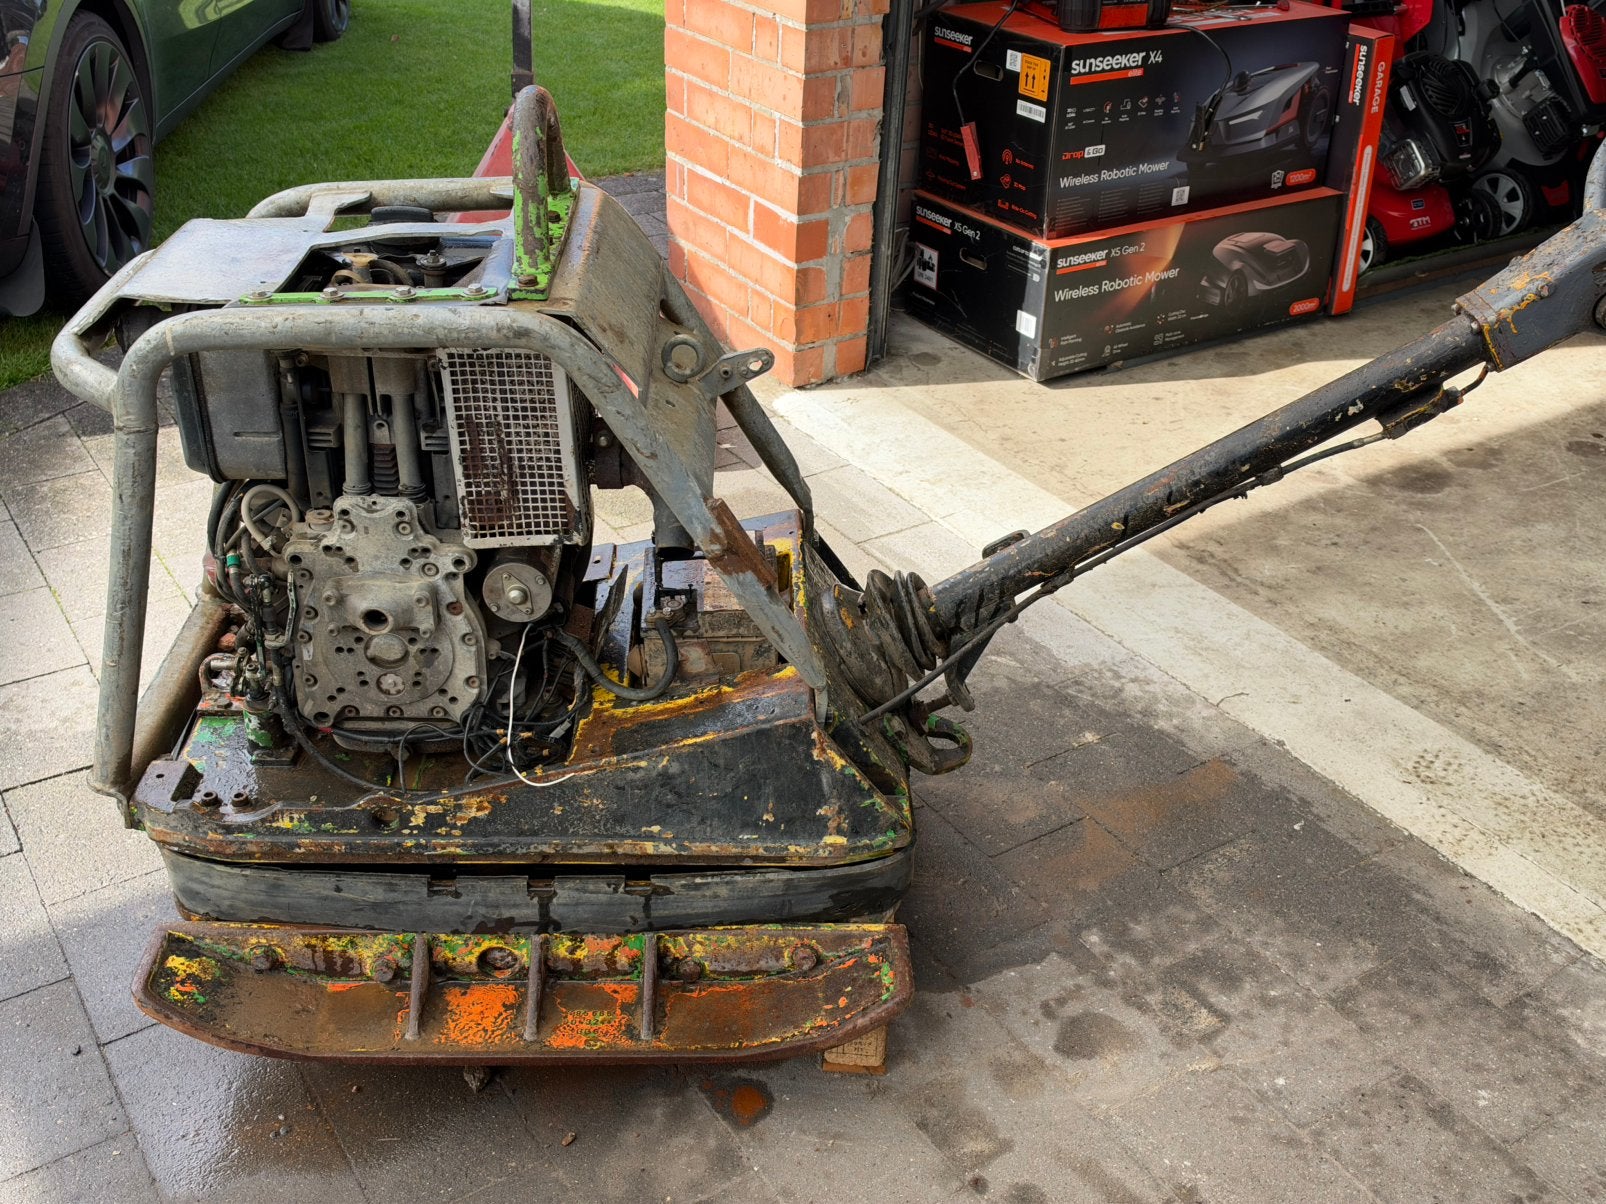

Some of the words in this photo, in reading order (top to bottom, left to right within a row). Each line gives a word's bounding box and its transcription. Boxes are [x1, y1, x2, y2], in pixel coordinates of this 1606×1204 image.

[934, 26, 973, 45] sunseeker
[1071, 51, 1146, 74] sunseeker
[1148, 50, 1163, 64] X4
[1353, 45, 1368, 106] sunseeker
[1371, 61, 1386, 113] GARAGE
[1060, 173, 1099, 189] Wireless
[1101, 166, 1137, 181] Robotic
[1139, 161, 1170, 175] Mower
[916, 205, 952, 227] sunseeker
[963, 225, 976, 238] Gen
[976, 230, 981, 240] 2
[1057, 249, 1108, 268] sunseeker
[1110, 246, 1121, 258] X5
[1121, 244, 1139, 255] Gen
[1140, 242, 1146, 252] 2
[1054, 284, 1100, 302] Wireless
[1101, 274, 1144, 293] Robotic
[1145, 267, 1180, 284] Mower
